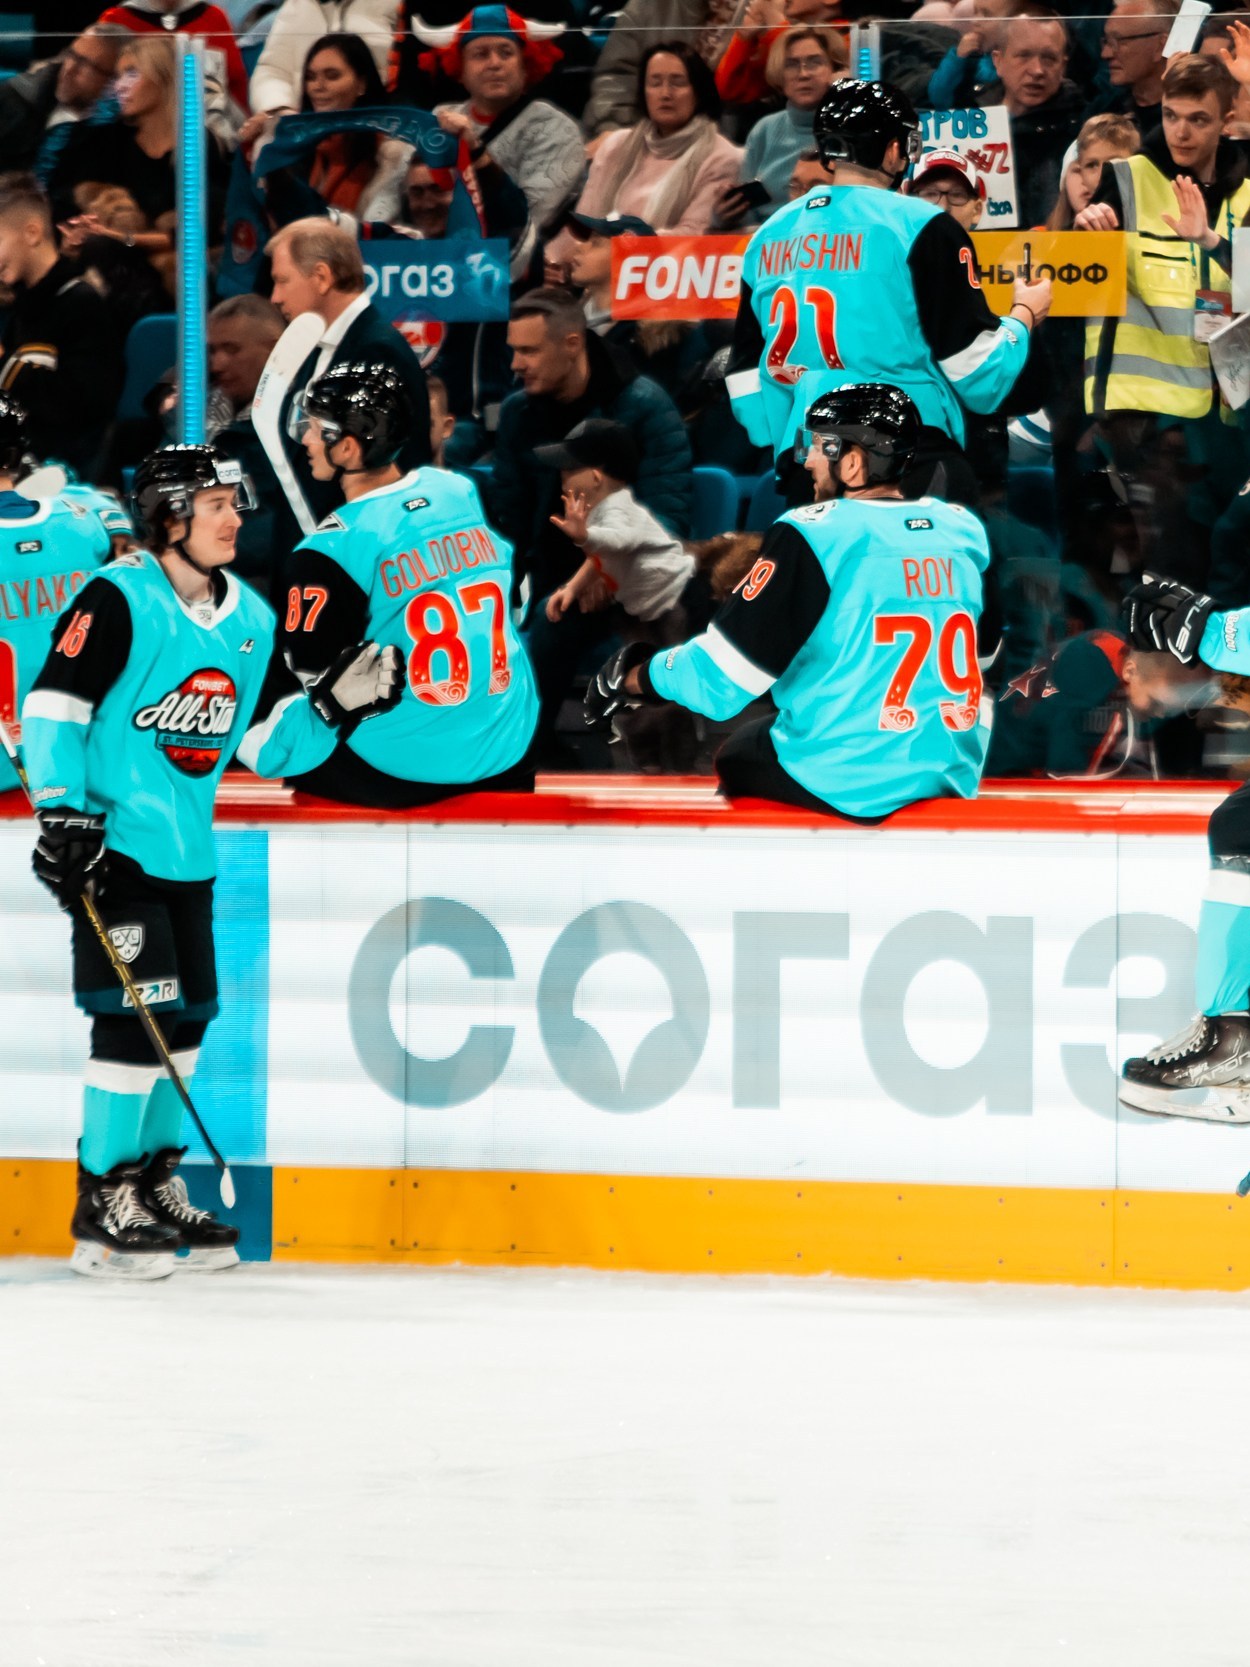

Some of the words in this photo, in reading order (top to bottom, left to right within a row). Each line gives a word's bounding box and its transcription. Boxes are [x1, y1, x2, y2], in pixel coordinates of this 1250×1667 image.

[758, 234, 863, 278] NIKISHIN
[766, 285, 846, 385] 21
[380, 527, 498, 598] GOLDOBIN
[902, 557, 954, 598] ROY
[0, 571, 92, 620] LYAKO
[285, 586, 328, 633] 87
[56, 610, 93, 658] 16
[404, 580, 511, 706] 87
[192, 680, 229, 692] FONBET
[873, 612, 984, 733] 79
[42, 818, 105, 829] TRU
[348, 896, 1213, 1124] согаз
